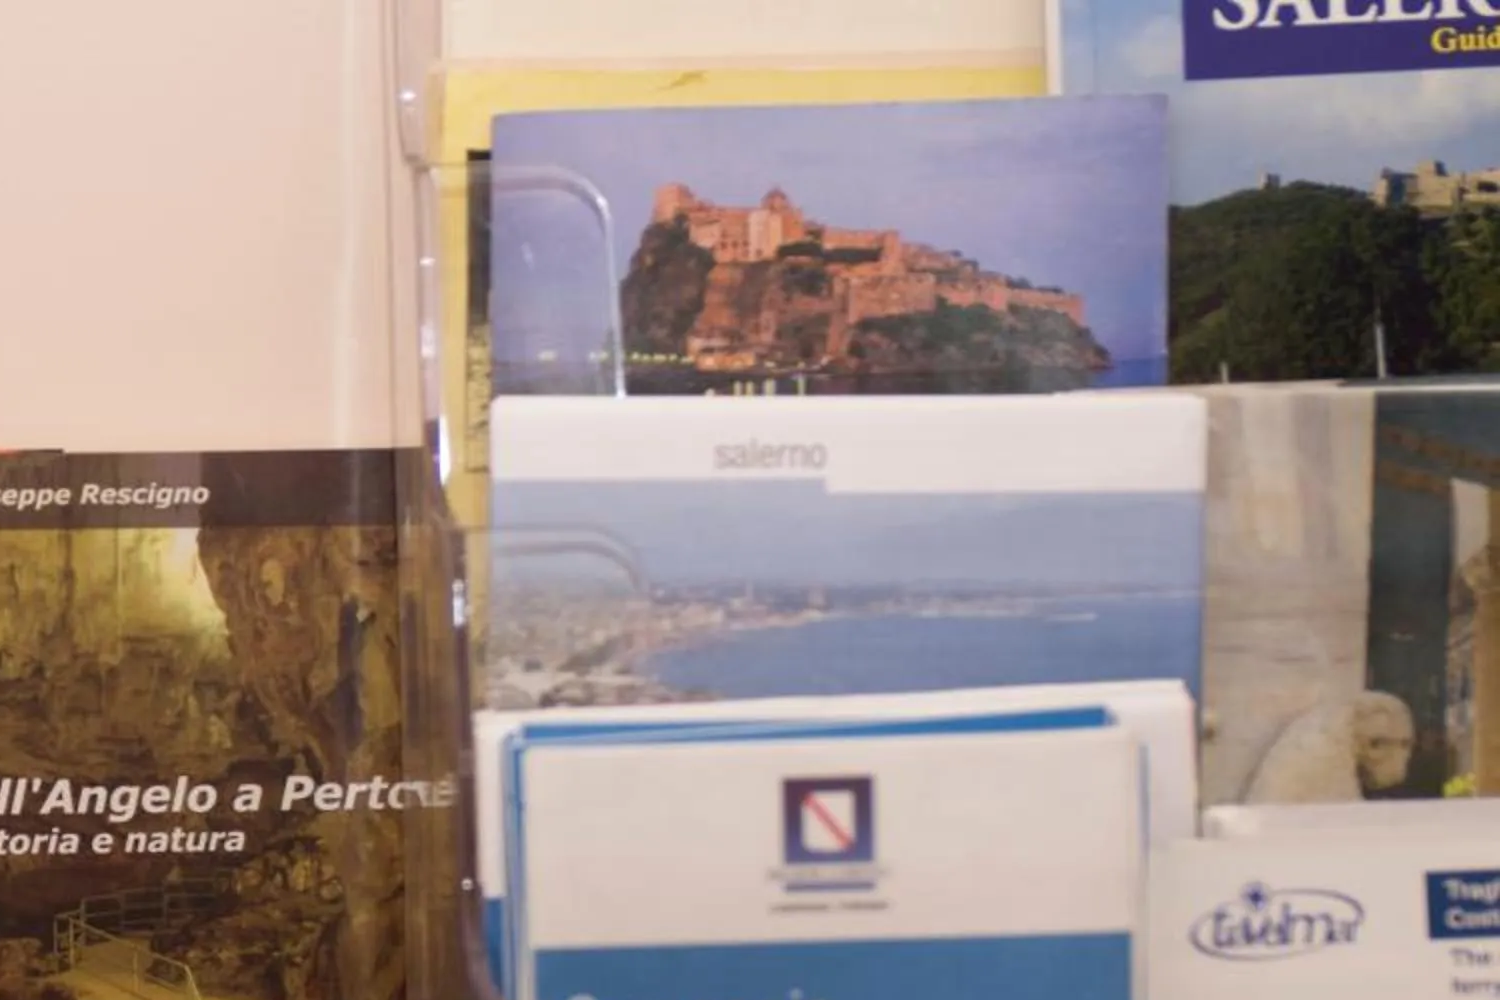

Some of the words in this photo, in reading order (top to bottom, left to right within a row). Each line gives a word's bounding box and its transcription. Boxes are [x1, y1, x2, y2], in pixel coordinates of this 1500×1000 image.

[713, 437, 828, 469] salerno
[80, 481, 211, 509] Rescigno
[232, 781, 264, 813] a
[91, 830, 115, 854] e
[124, 829, 247, 854] natura
